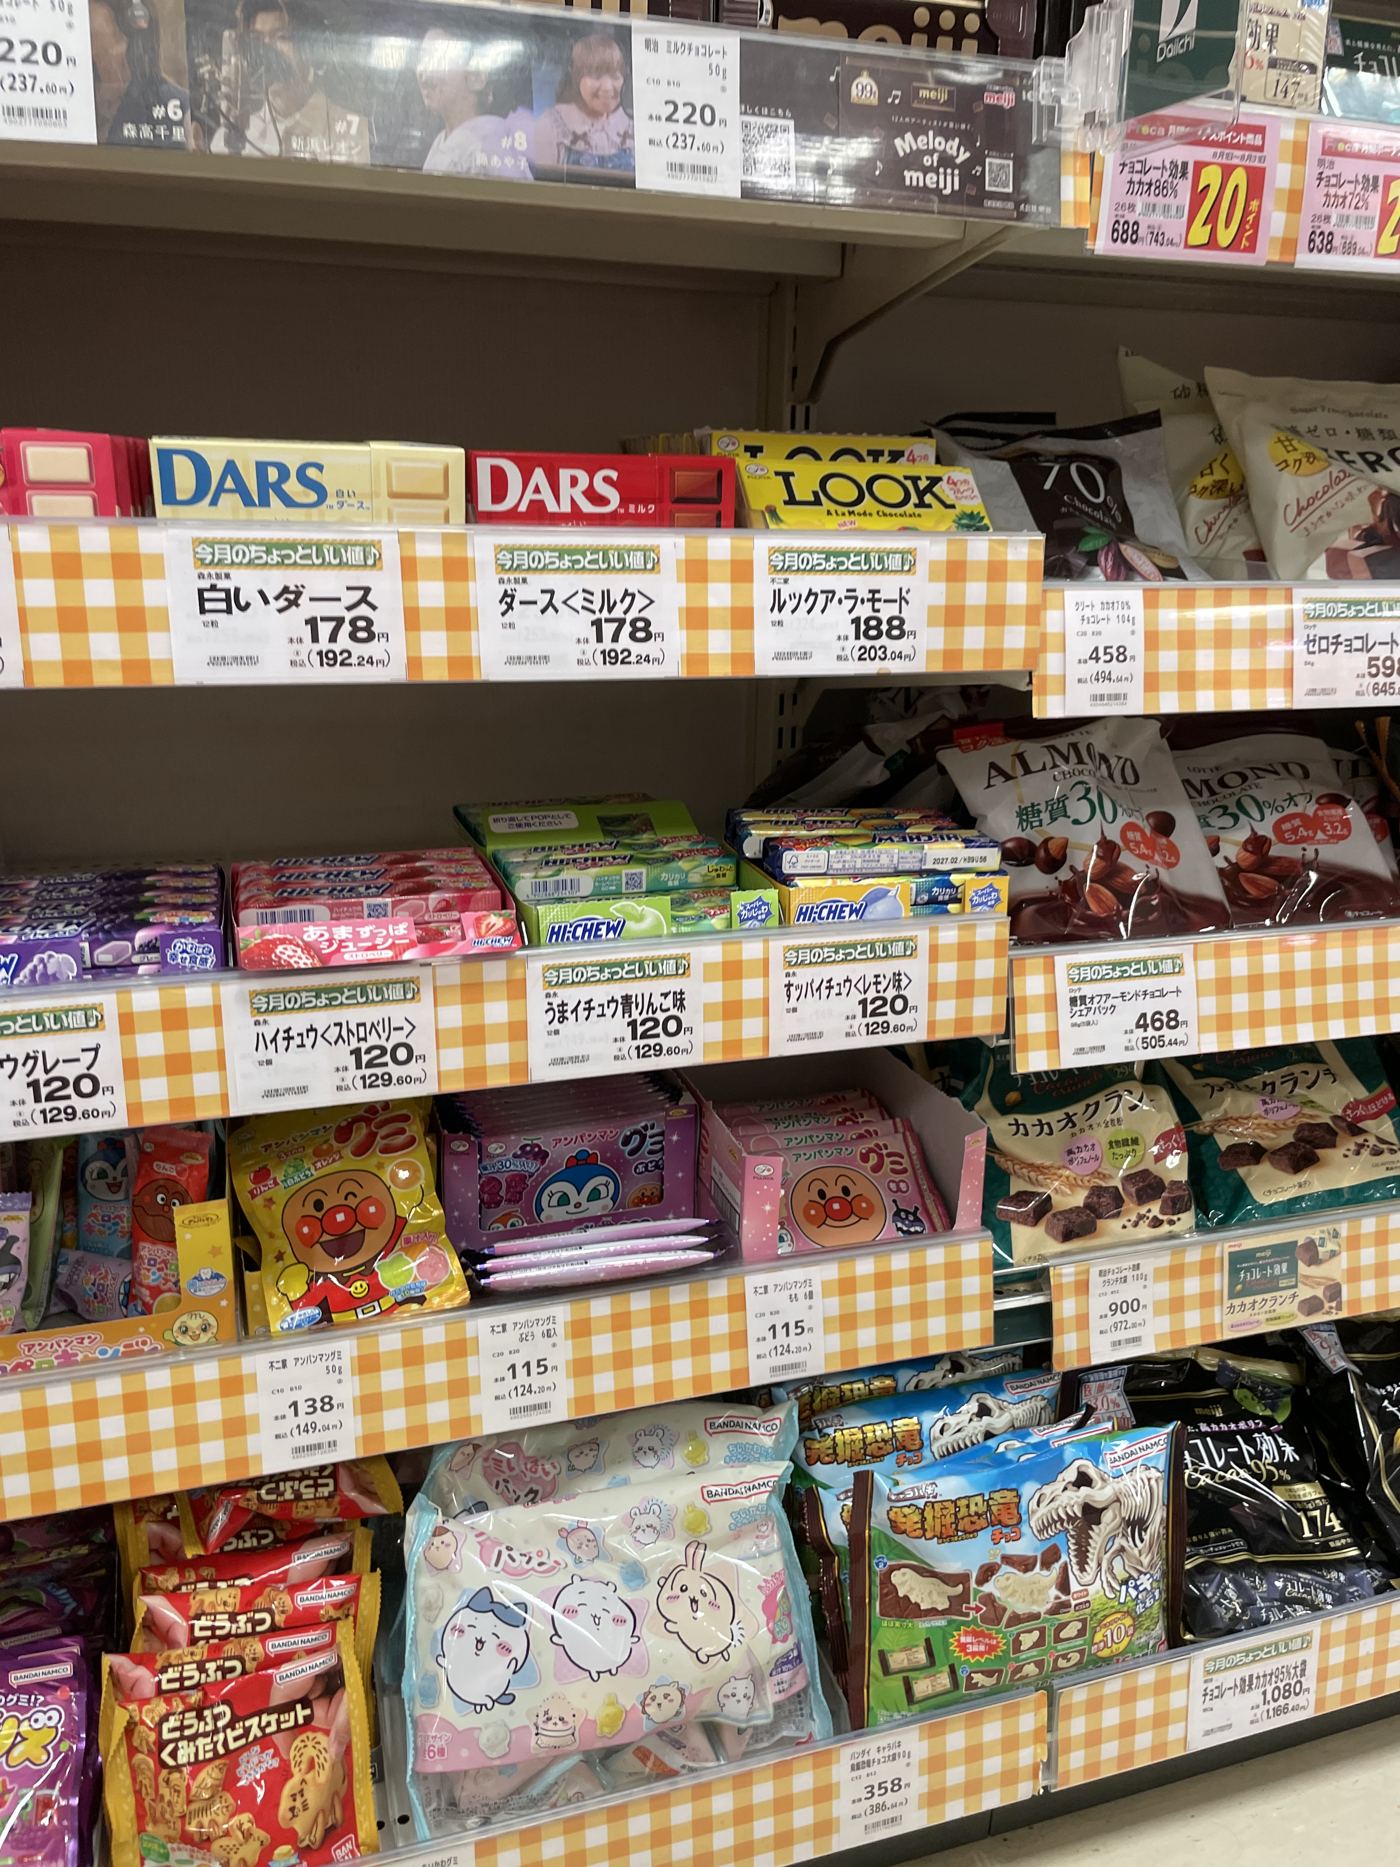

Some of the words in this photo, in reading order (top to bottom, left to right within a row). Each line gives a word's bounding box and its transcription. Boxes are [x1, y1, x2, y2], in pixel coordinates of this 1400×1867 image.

[152, 99, 183, 120] #6
[894, 129, 971, 165] Melody
[923, 153, 939, 167] of
[903, 167, 960, 195] meiji
[1187, 164, 1248, 249] 20
[156, 447, 328, 509] DARS
[476, 457, 621, 514] DARS
[774, 470, 957, 511] LOOK
[335, 488, 356, 498] 白い
[628, 503, 655, 514] ミルク
[197, 584, 378, 616] 白いダース
[498, 587, 656, 617] ダース<ミルク>
[769, 587, 910, 615] ルックア・ラ・モード
[304, 616, 390, 644] 178円
[590, 616, 665, 644] 178円
[850, 616, 917, 641] 188円
[850, 644, 916, 663] (203.04円)
[1304, 632, 1399, 656] ゼロチョコレート
[306, 648, 391, 669] (192.24円)
[592, 647, 665, 667] (192.24円)
[1182, 761, 1311, 800] MOND
[303, 921, 408, 943] あまずっぱ
[319, 937, 409, 953] ジューシー
[545, 988, 686, 1026] うまイチュウ青りんご味
[858, 994, 918, 1018] 120円
[626, 1015, 693, 1041] 120円
[857, 1017, 918, 1036] (129.60円)
[1135, 1008, 1189, 1033] 468円
[254, 1016, 416, 1053] ハイチュウ<ストロベリー>
[350, 1041, 426, 1070] 120円
[628, 1039, 693, 1061] (129.60円)
[27, 1073, 114, 1104] 120円
[352, 1068, 427, 1091] (129.60円)
[31, 1101, 117, 1126] (129.60円)
[1007, 1089, 1155, 1137] カカオクラン
[333, 1101, 418, 1160] グミ
[552, 1128, 620, 1148] アンパンマン
[792, 1146, 854, 1163] アンパンマン
[859, 1142, 908, 1176] グミ
[773, 1279, 813, 1293] アンパンマングミ
[789, 1293, 799, 1303] もも
[1225, 1291, 1300, 1316] カカオクランチ
[513, 1315, 557, 1332] アンパンマングミ
[768, 1319, 814, 1340] 115円
[23, 1334, 99, 1354] アンパンマン
[294, 1350, 342, 1367] アンパンマングミ
[325, 1364, 343, 1375] 50g
[507, 1357, 558, 1380] 115円
[288, 1395, 345, 1418] 138円
[1184, 1432, 1300, 1470] コレート効果
[887, 1489, 1022, 1540] 発掘恐竜
[1299, 1504, 1345, 1538] 174
[990, 1528, 1022, 1544] チョコ
[192, 1611, 272, 1638] どうぶつ
[1103, 1623, 1125, 1649] 10
[271, 1640, 300, 1650] BANDAI
[300, 1634, 328, 1645] NAMCO
[13, 1671, 41, 1682] BANDAI
[41, 1667, 68, 1678] NAMCO
[159, 1658, 243, 1691] どうぶつ
[278, 1667, 308, 1682] BANDAI
[308, 1656, 335, 1672] NAMCO
[160, 1703, 232, 1740] どうぶつ
[159, 1702, 313, 1767] くみたてビスケット
[864, 1777, 911, 1801] 358円
